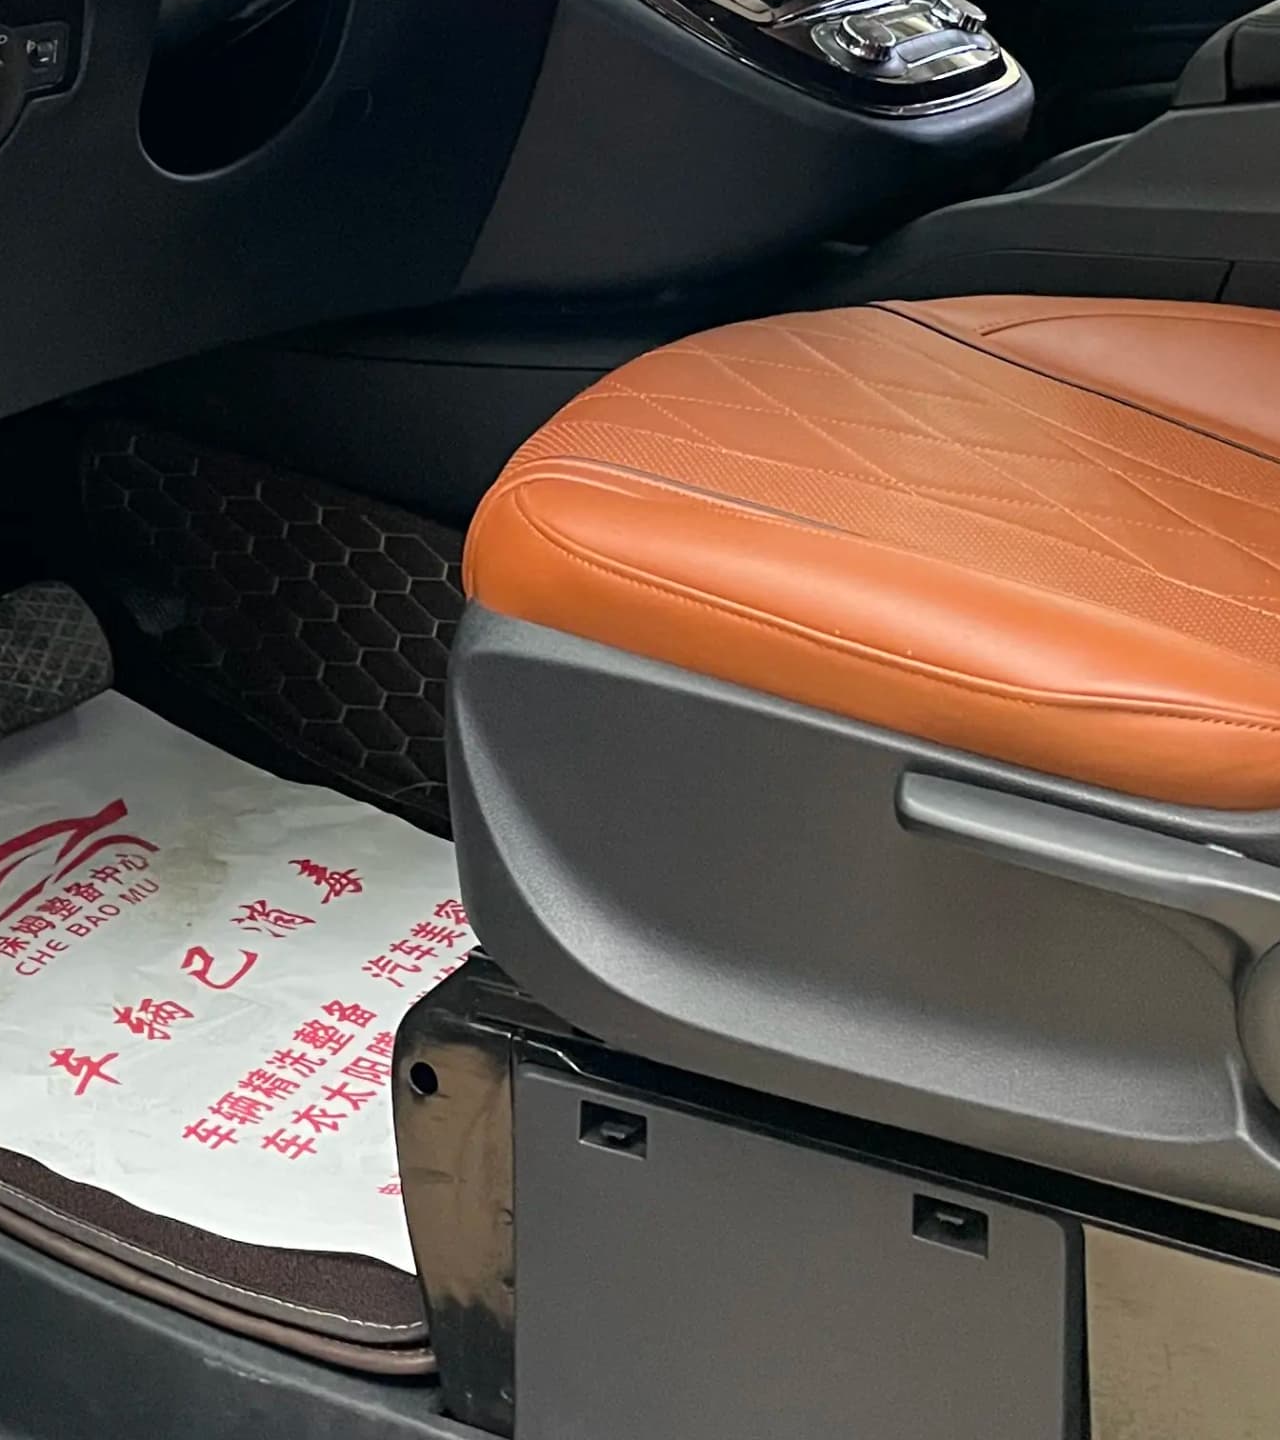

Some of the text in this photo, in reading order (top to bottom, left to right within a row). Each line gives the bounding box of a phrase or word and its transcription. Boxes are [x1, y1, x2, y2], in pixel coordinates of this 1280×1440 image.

[15, 877, 160, 976] CHE BAO MU
[181, 999, 378, 1150] 车辆精洗整备
